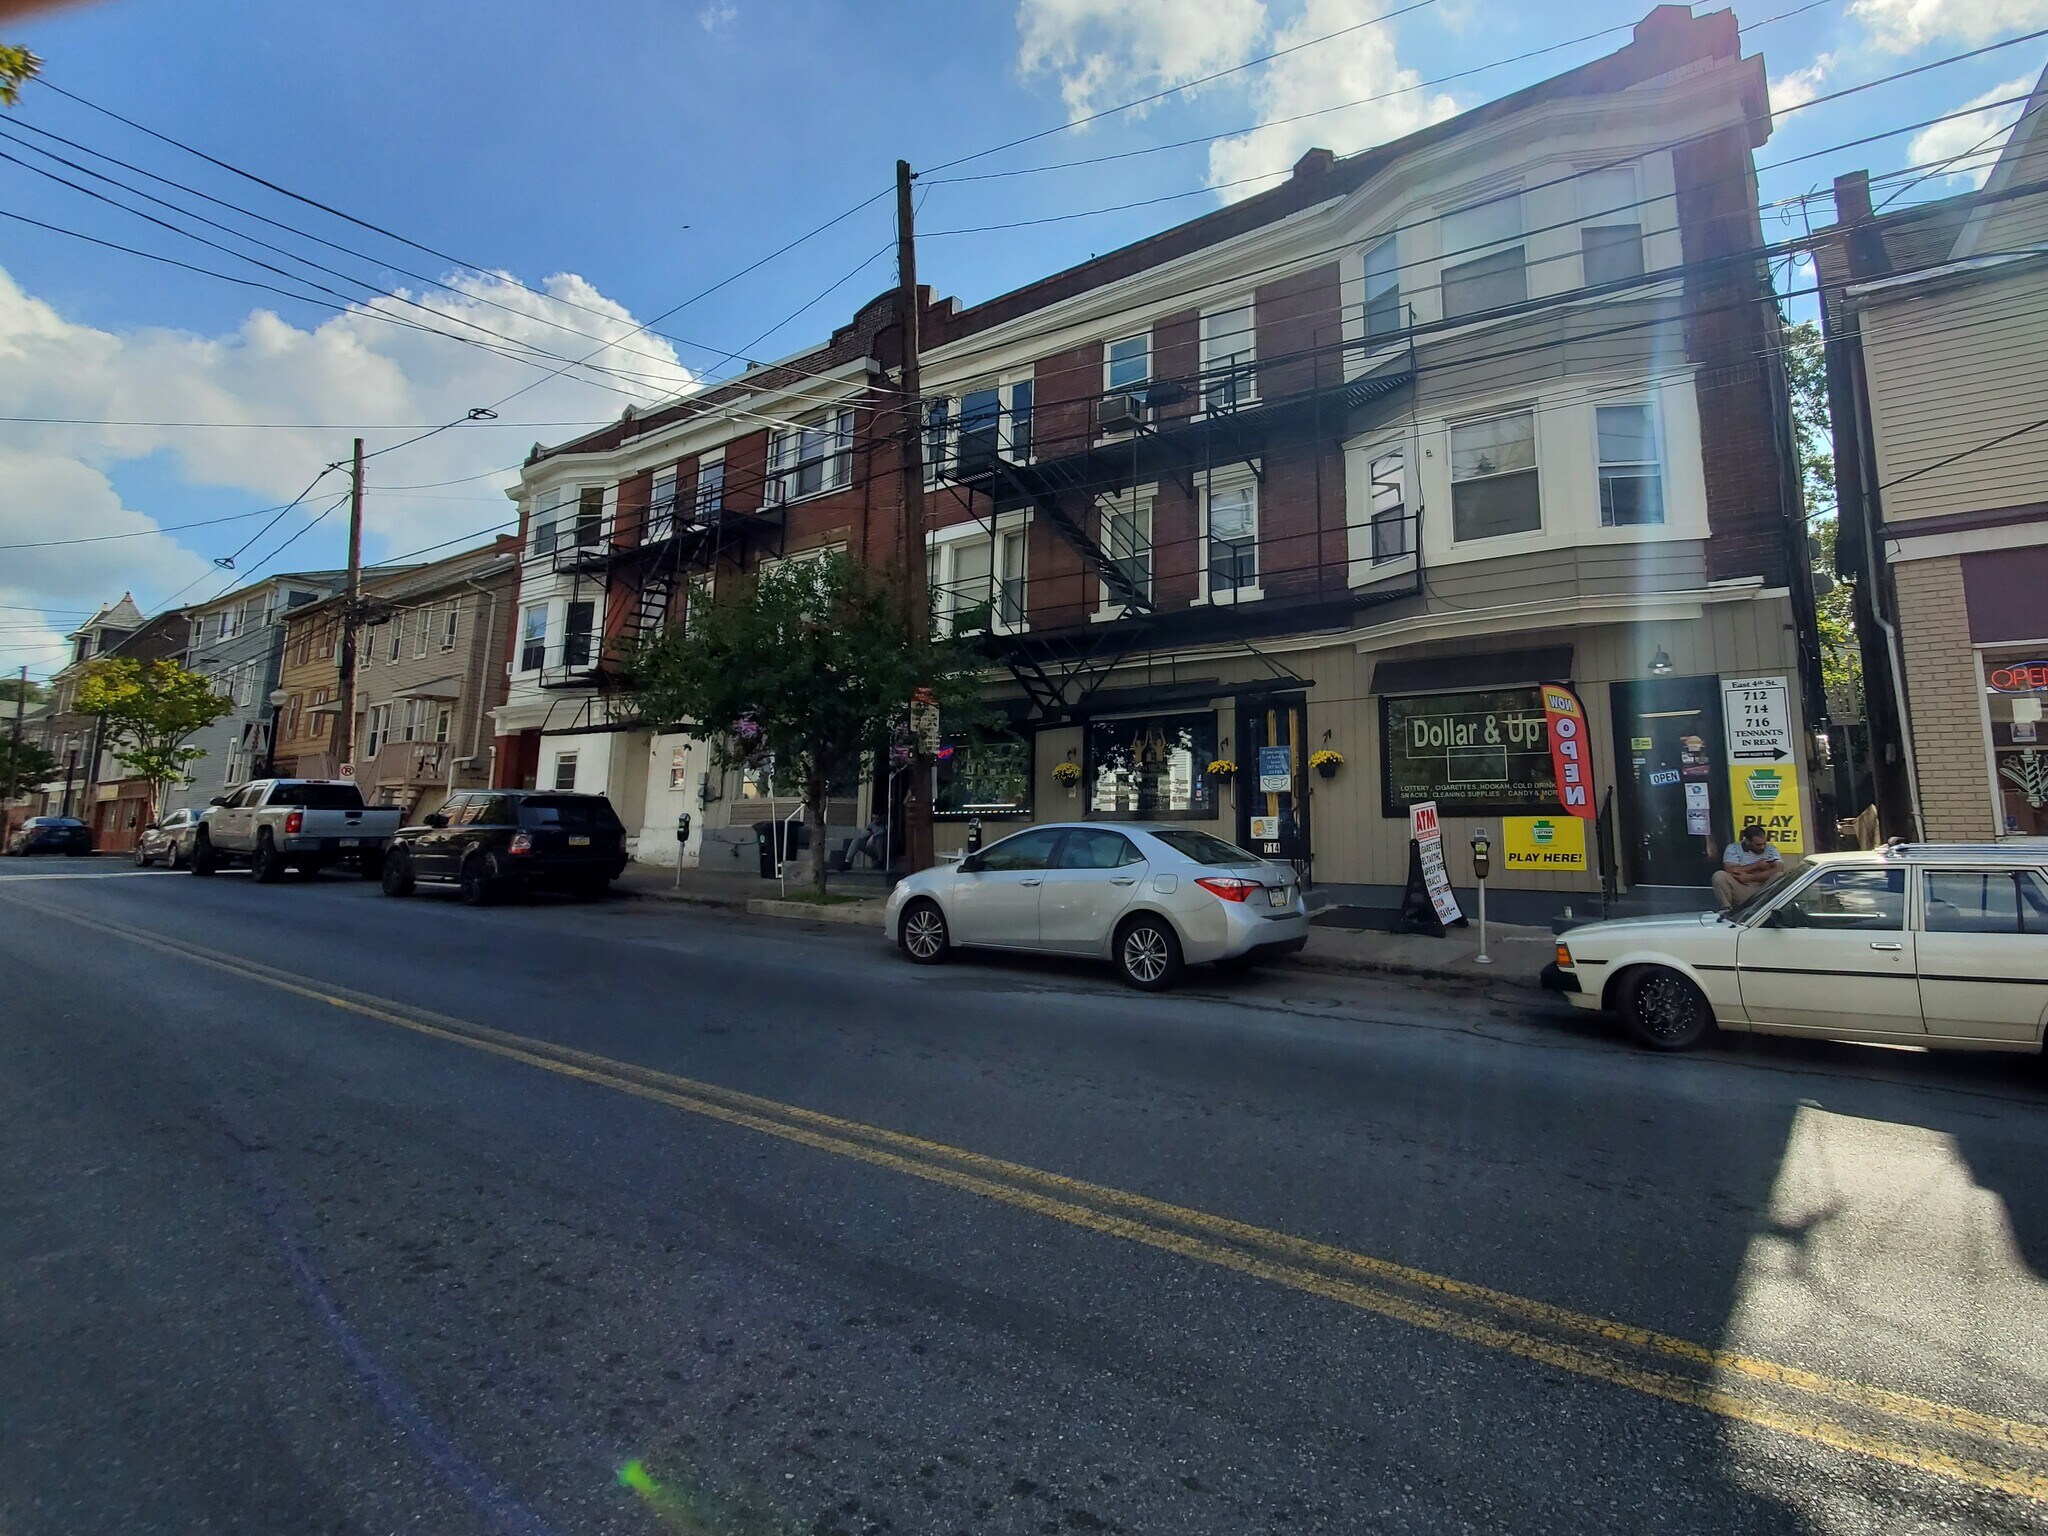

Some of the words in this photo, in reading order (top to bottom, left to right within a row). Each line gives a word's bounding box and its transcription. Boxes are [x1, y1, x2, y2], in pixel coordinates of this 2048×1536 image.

[1743, 691, 1767, 701] 712
[1744, 704, 1768, 714] 714
[1746, 717, 1770, 728] 716
[1413, 718, 1477, 748] Dollar
[1484, 714, 1501, 745] &
[1507, 713, 1540, 749] Up
[1734, 728, 1784, 738] TENNANTS
[1741, 739, 1752, 747] IN
[1753, 738, 1778, 746] REAR
[1653, 771, 1678, 784] OPEN
[1416, 808, 1437, 833] ATM
[1743, 815, 1794, 828] PLAY
[1738, 829, 1798, 843] RE!
[1265, 843, 1279, 852] 714
[1508, 852, 1540, 862] PLAY
[1543, 853, 1583, 863] HERE!
